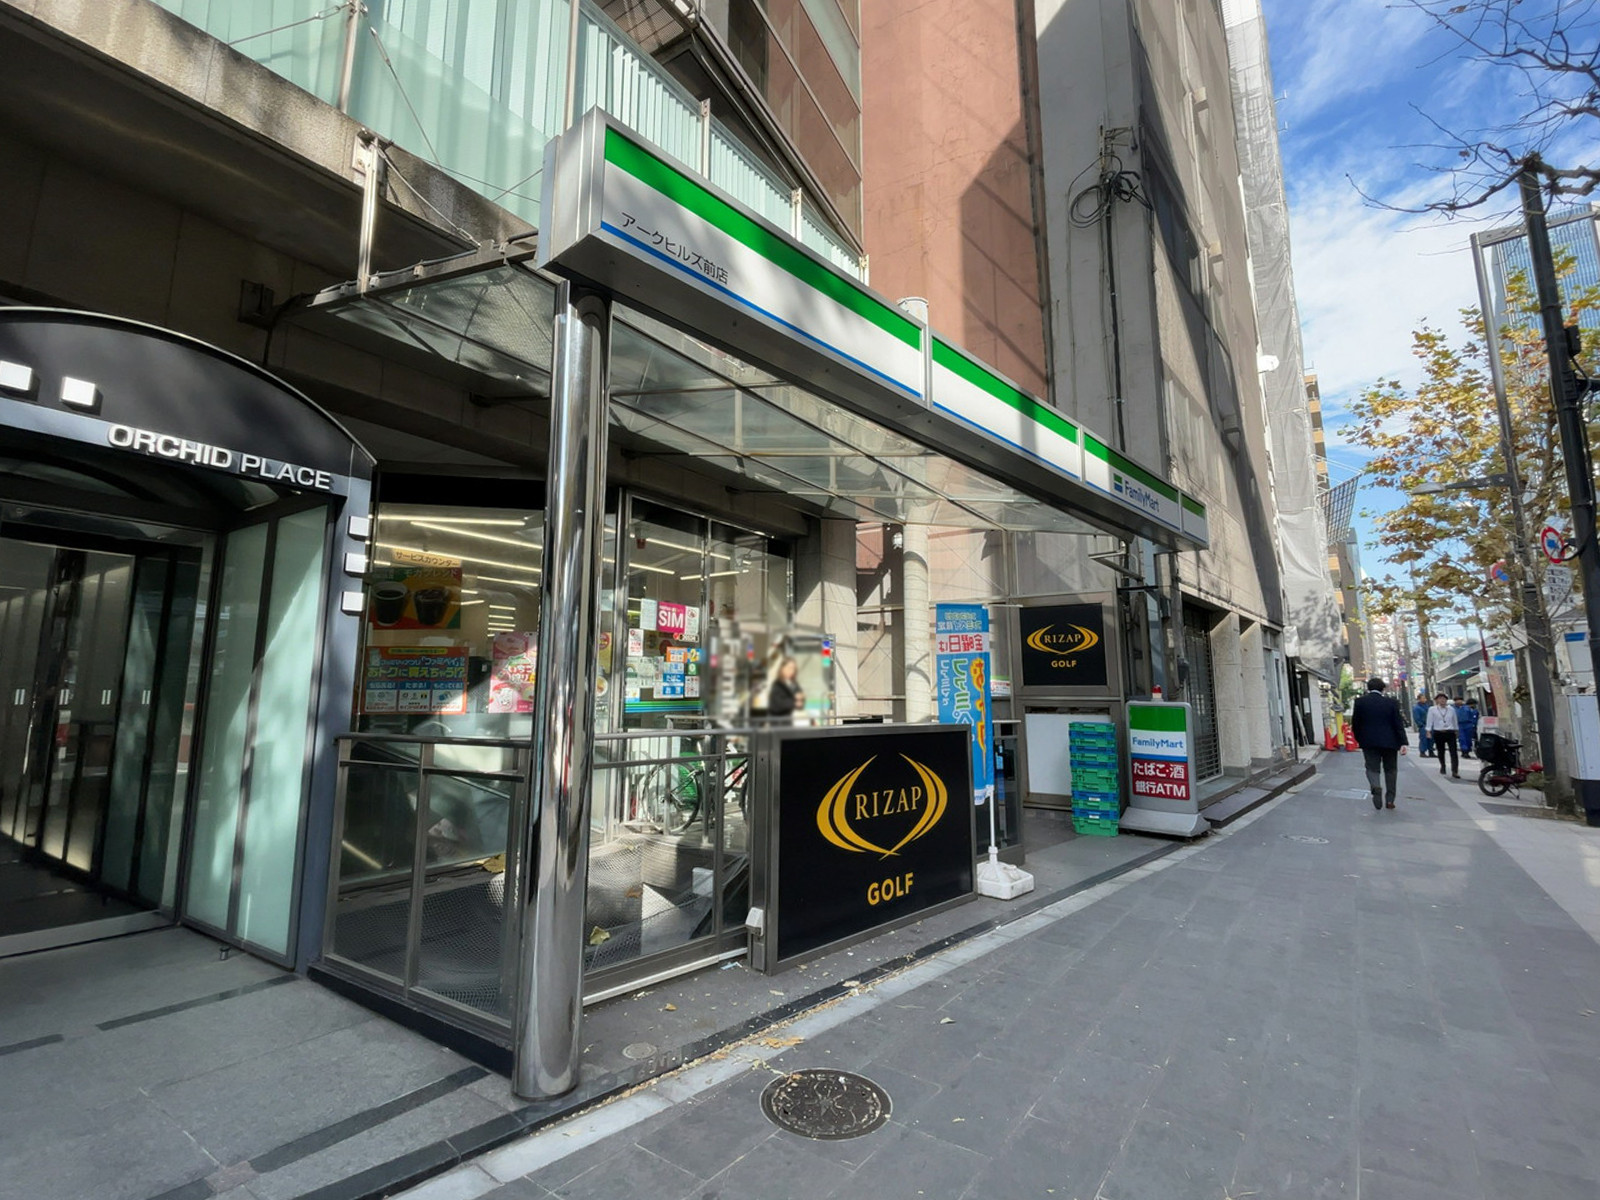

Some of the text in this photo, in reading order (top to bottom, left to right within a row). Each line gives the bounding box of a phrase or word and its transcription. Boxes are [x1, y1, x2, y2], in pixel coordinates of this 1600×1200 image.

[107, 424, 332, 491] ORCHID PLACE
[1124, 480, 1160, 513] FamilyMart
[658, 610, 684, 629] SIM
[1043, 633, 1082, 644] RIZAP
[1050, 660, 1078, 668] GOLF
[1132, 737, 1184, 749] FamilyMart
[1135, 780, 1186, 798] 銀行ATM
[855, 785, 922, 820] RIZAP
[867, 872, 914, 906] GOLF
